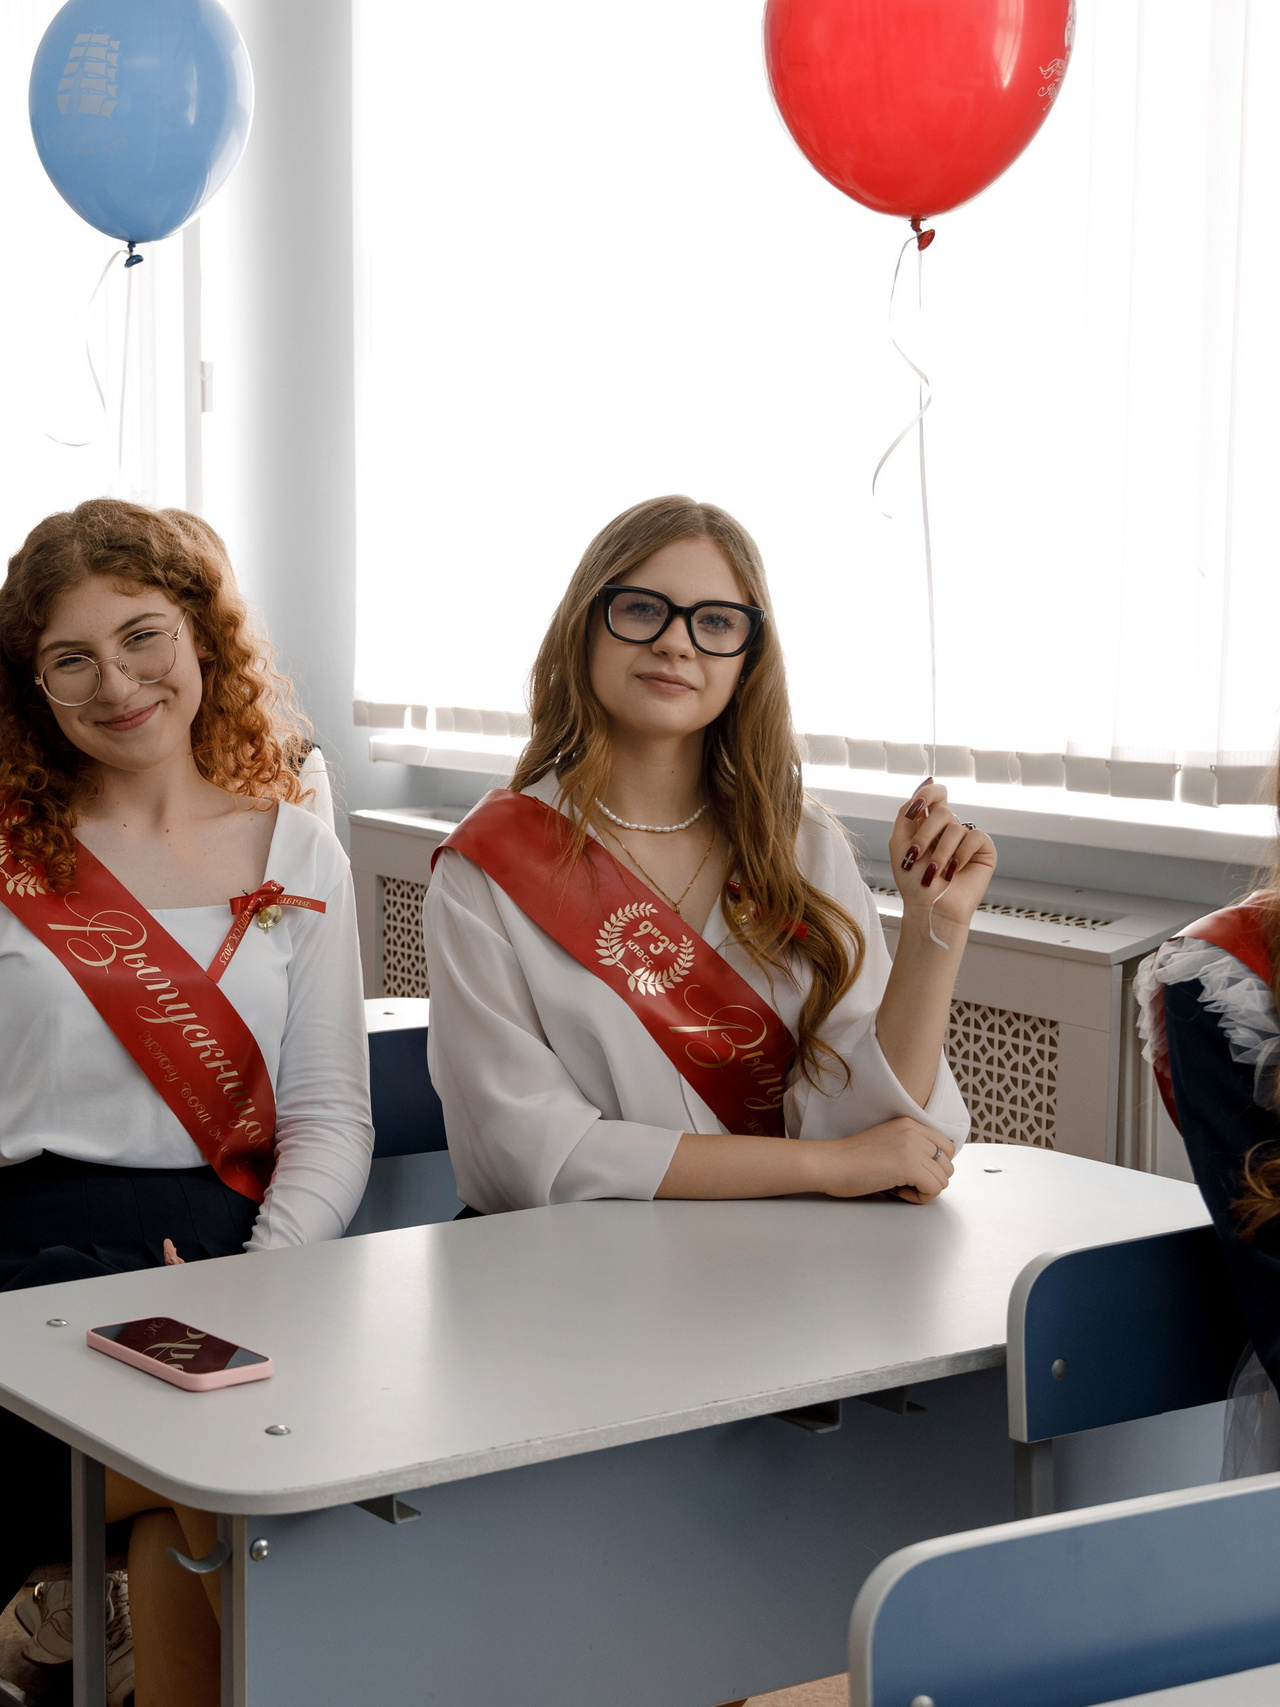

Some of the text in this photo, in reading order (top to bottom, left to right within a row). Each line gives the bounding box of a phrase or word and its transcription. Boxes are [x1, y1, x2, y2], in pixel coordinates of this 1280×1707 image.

[220, 943, 234, 965] 2025
[625, 939, 654, 968] класс
[46, 891, 269, 1150] Выпускница
